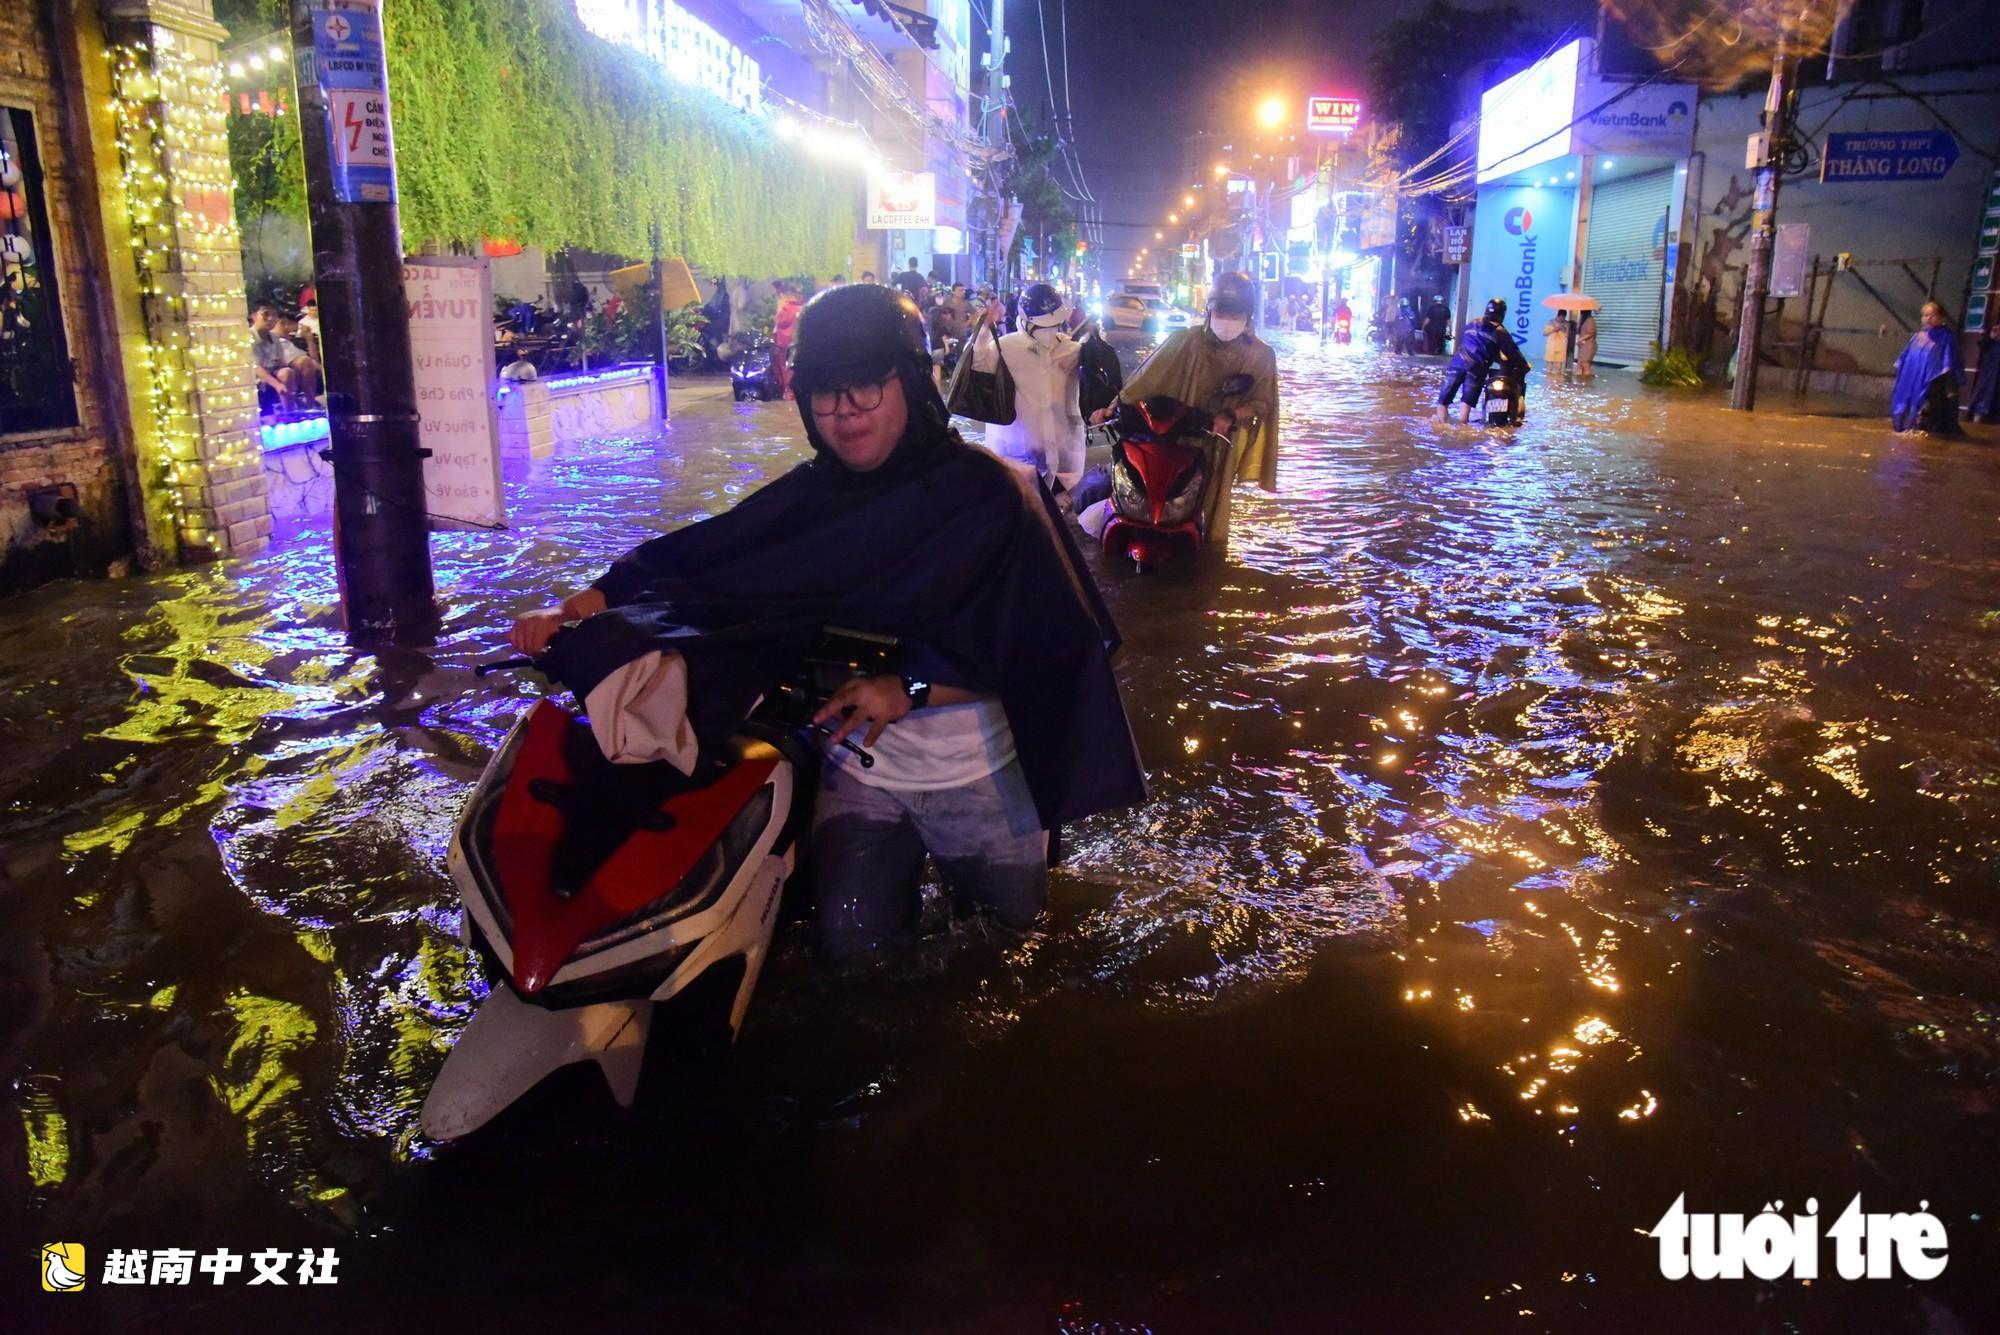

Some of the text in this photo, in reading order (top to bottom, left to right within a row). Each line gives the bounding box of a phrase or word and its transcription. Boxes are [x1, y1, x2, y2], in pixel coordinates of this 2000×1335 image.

[1314, 102, 1354, 115] WIN
[1896, 156, 1946, 175] LONG
[883, 214, 913, 224] COFFEE
[761, 877, 780, 926] HONDA
